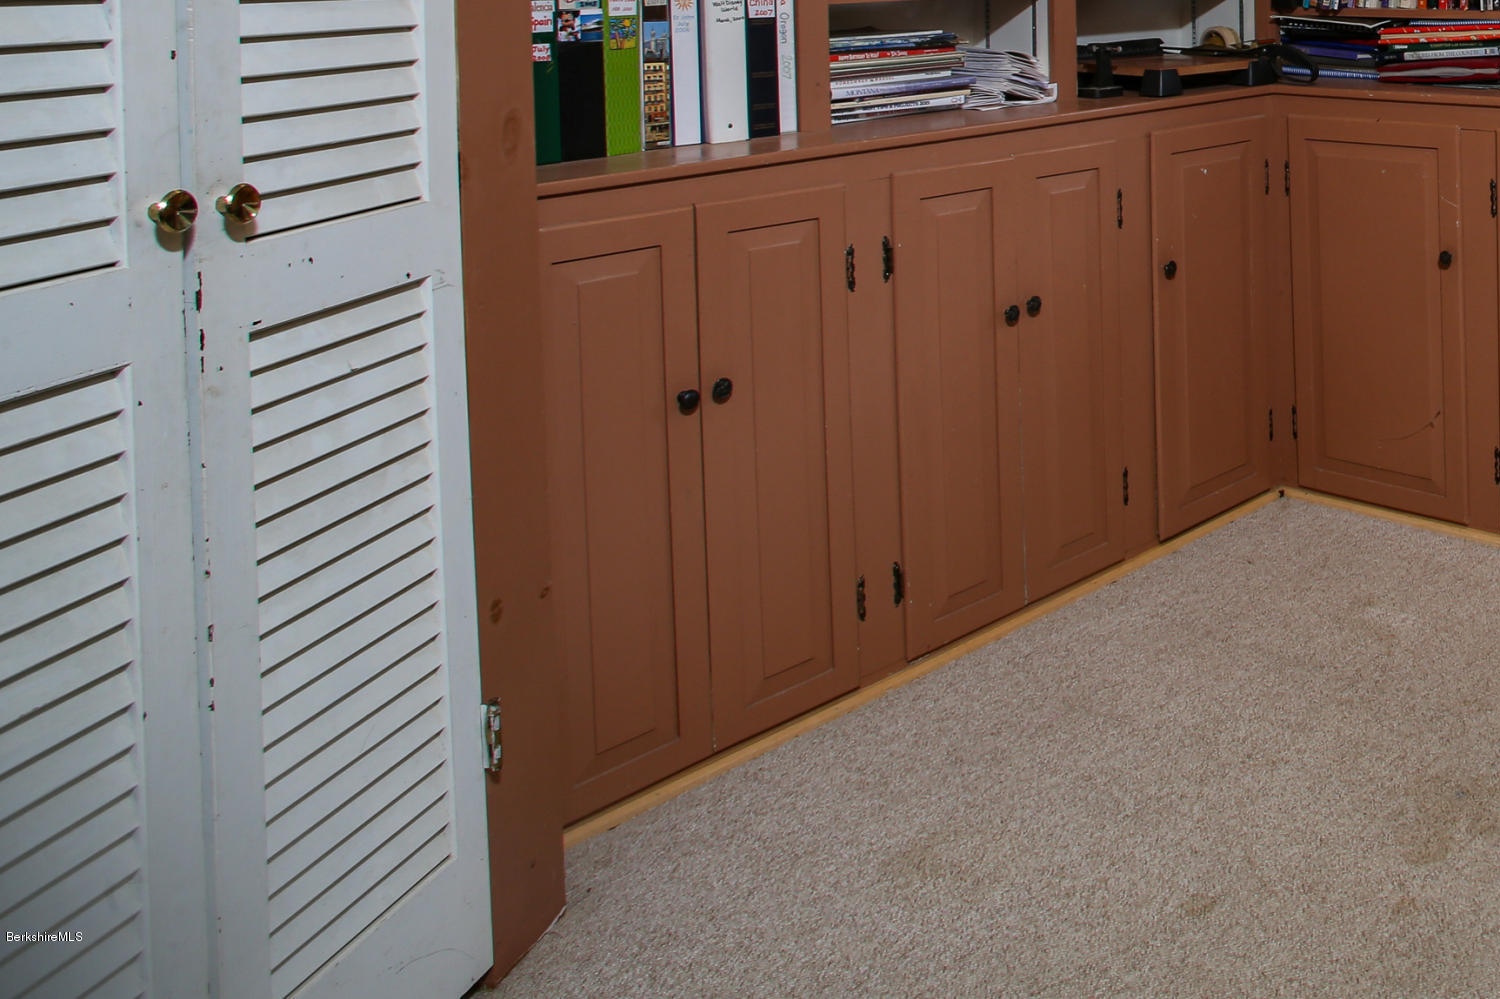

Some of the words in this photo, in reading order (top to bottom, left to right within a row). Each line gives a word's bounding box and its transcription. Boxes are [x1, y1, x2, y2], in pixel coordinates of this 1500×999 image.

[779, 12, 790, 44] Oregon
[532, 46, 550, 54] July
[846, 87, 880, 96] MONTANA
